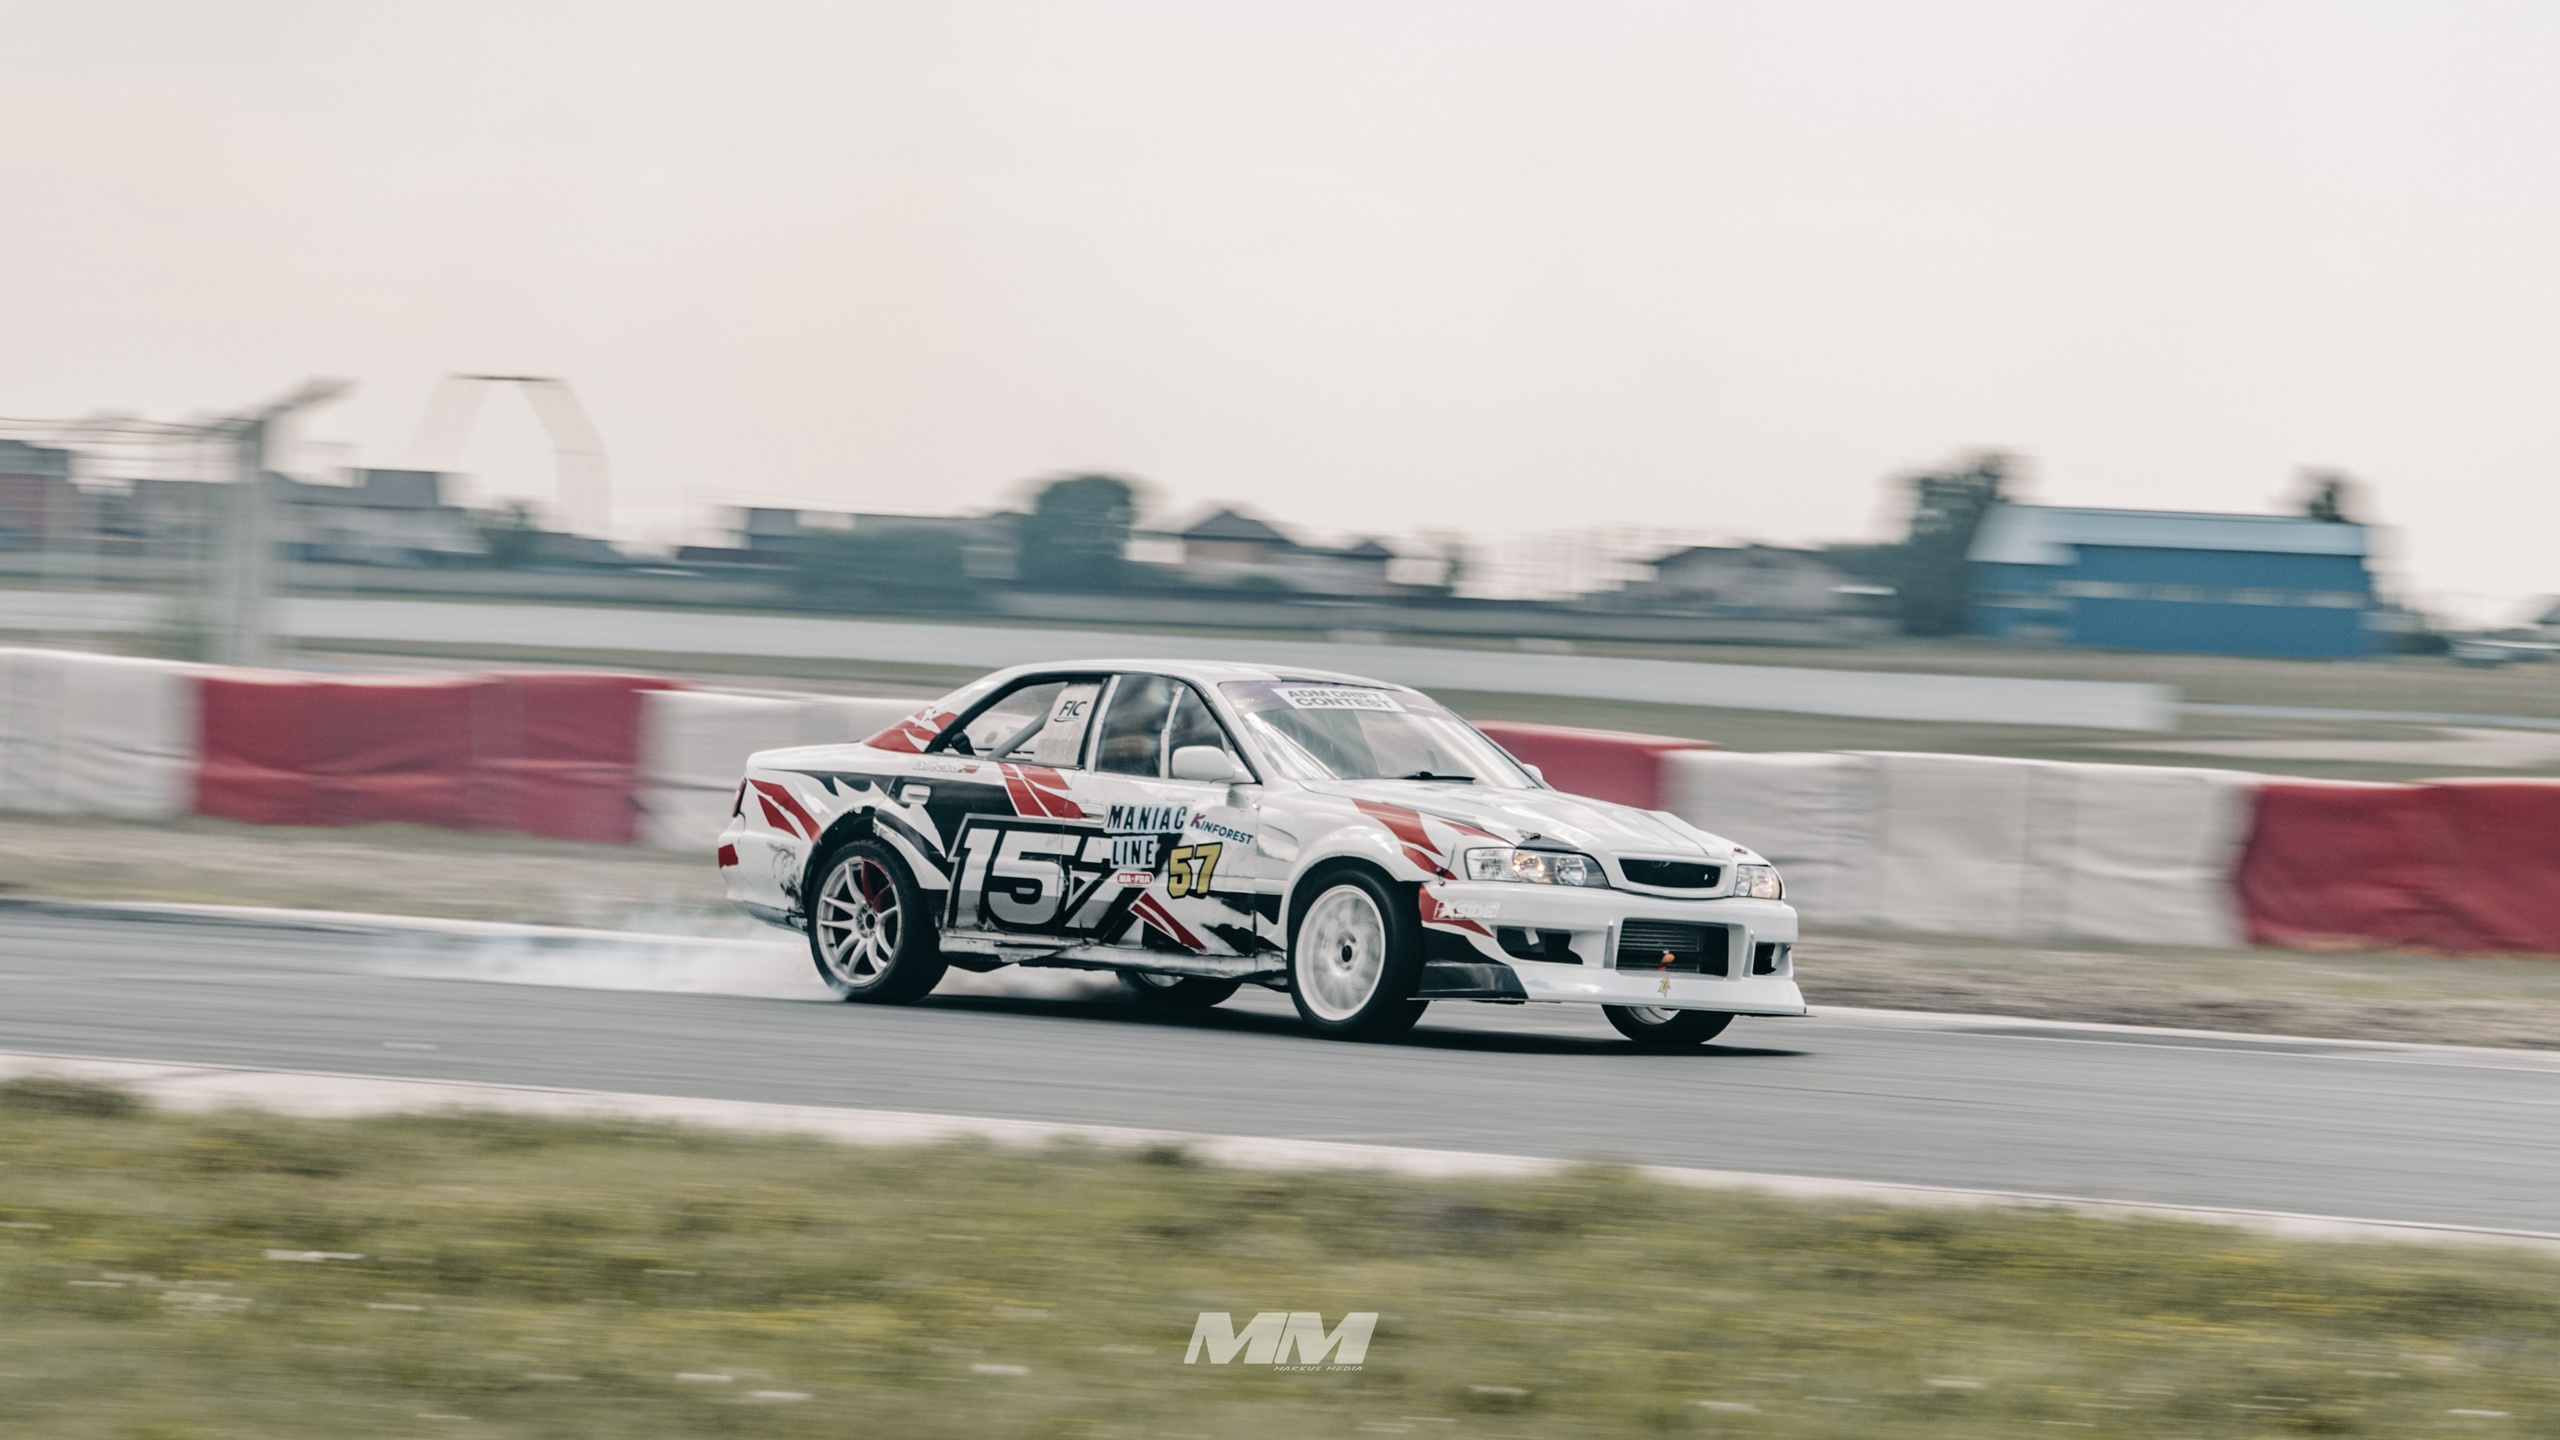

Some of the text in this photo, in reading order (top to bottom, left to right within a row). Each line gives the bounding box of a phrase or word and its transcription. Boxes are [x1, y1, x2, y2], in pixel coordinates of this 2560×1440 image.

[1059, 700, 1088, 716] FIC
[1287, 690, 1382, 700] ADM DRIFT
[1295, 698, 1392, 709] CONTEST
[1107, 804, 1188, 830] MANIAC
[1190, 812, 1254, 845] KINFOREST
[1112, 839, 1154, 866] LINE
[953, 827, 1145, 931] 157
[1167, 841, 1223, 899] 57
